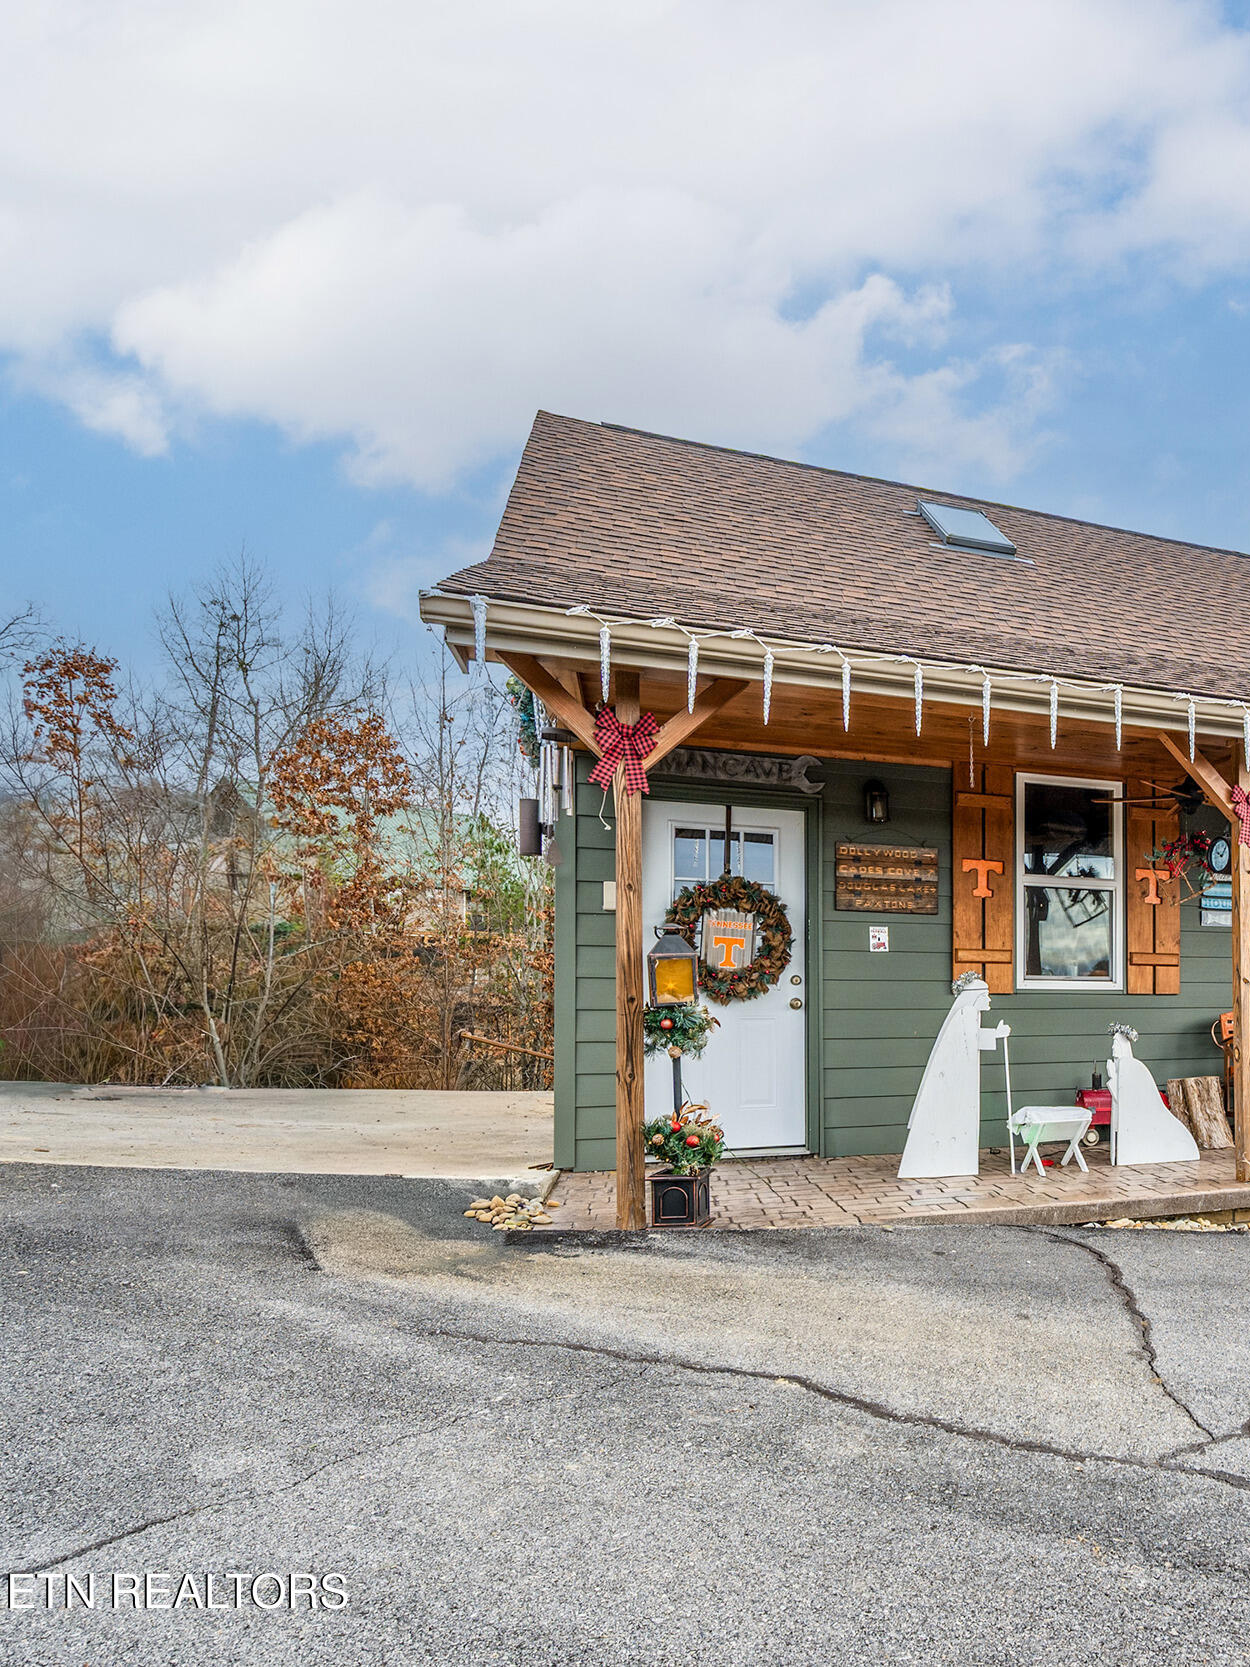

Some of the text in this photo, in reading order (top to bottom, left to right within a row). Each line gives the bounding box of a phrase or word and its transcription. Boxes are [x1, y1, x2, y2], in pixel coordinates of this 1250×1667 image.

[839, 864, 920, 877] CADES COVE
[839, 881, 930, 894] DOUGLAS LAKE
[708, 919, 753, 931] TENNESSEE
[713, 936, 745, 968] T
